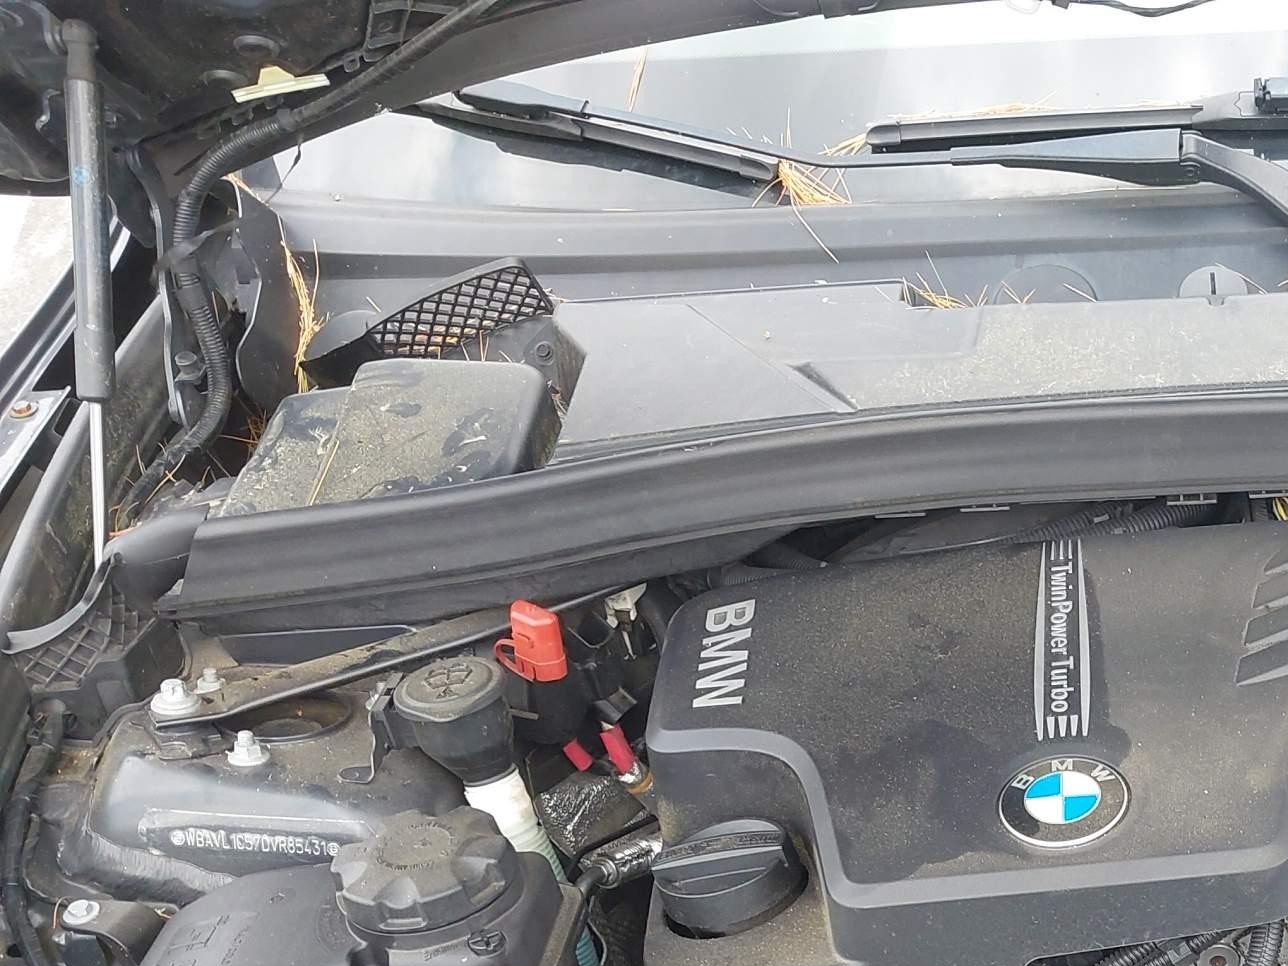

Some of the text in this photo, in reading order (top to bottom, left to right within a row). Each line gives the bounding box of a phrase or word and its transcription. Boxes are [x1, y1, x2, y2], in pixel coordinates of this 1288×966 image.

[692, 599, 756, 708] BMW
[1050, 561, 1075, 713] TwinPower Turbo
[1010, 758, 1117, 791] BMW
